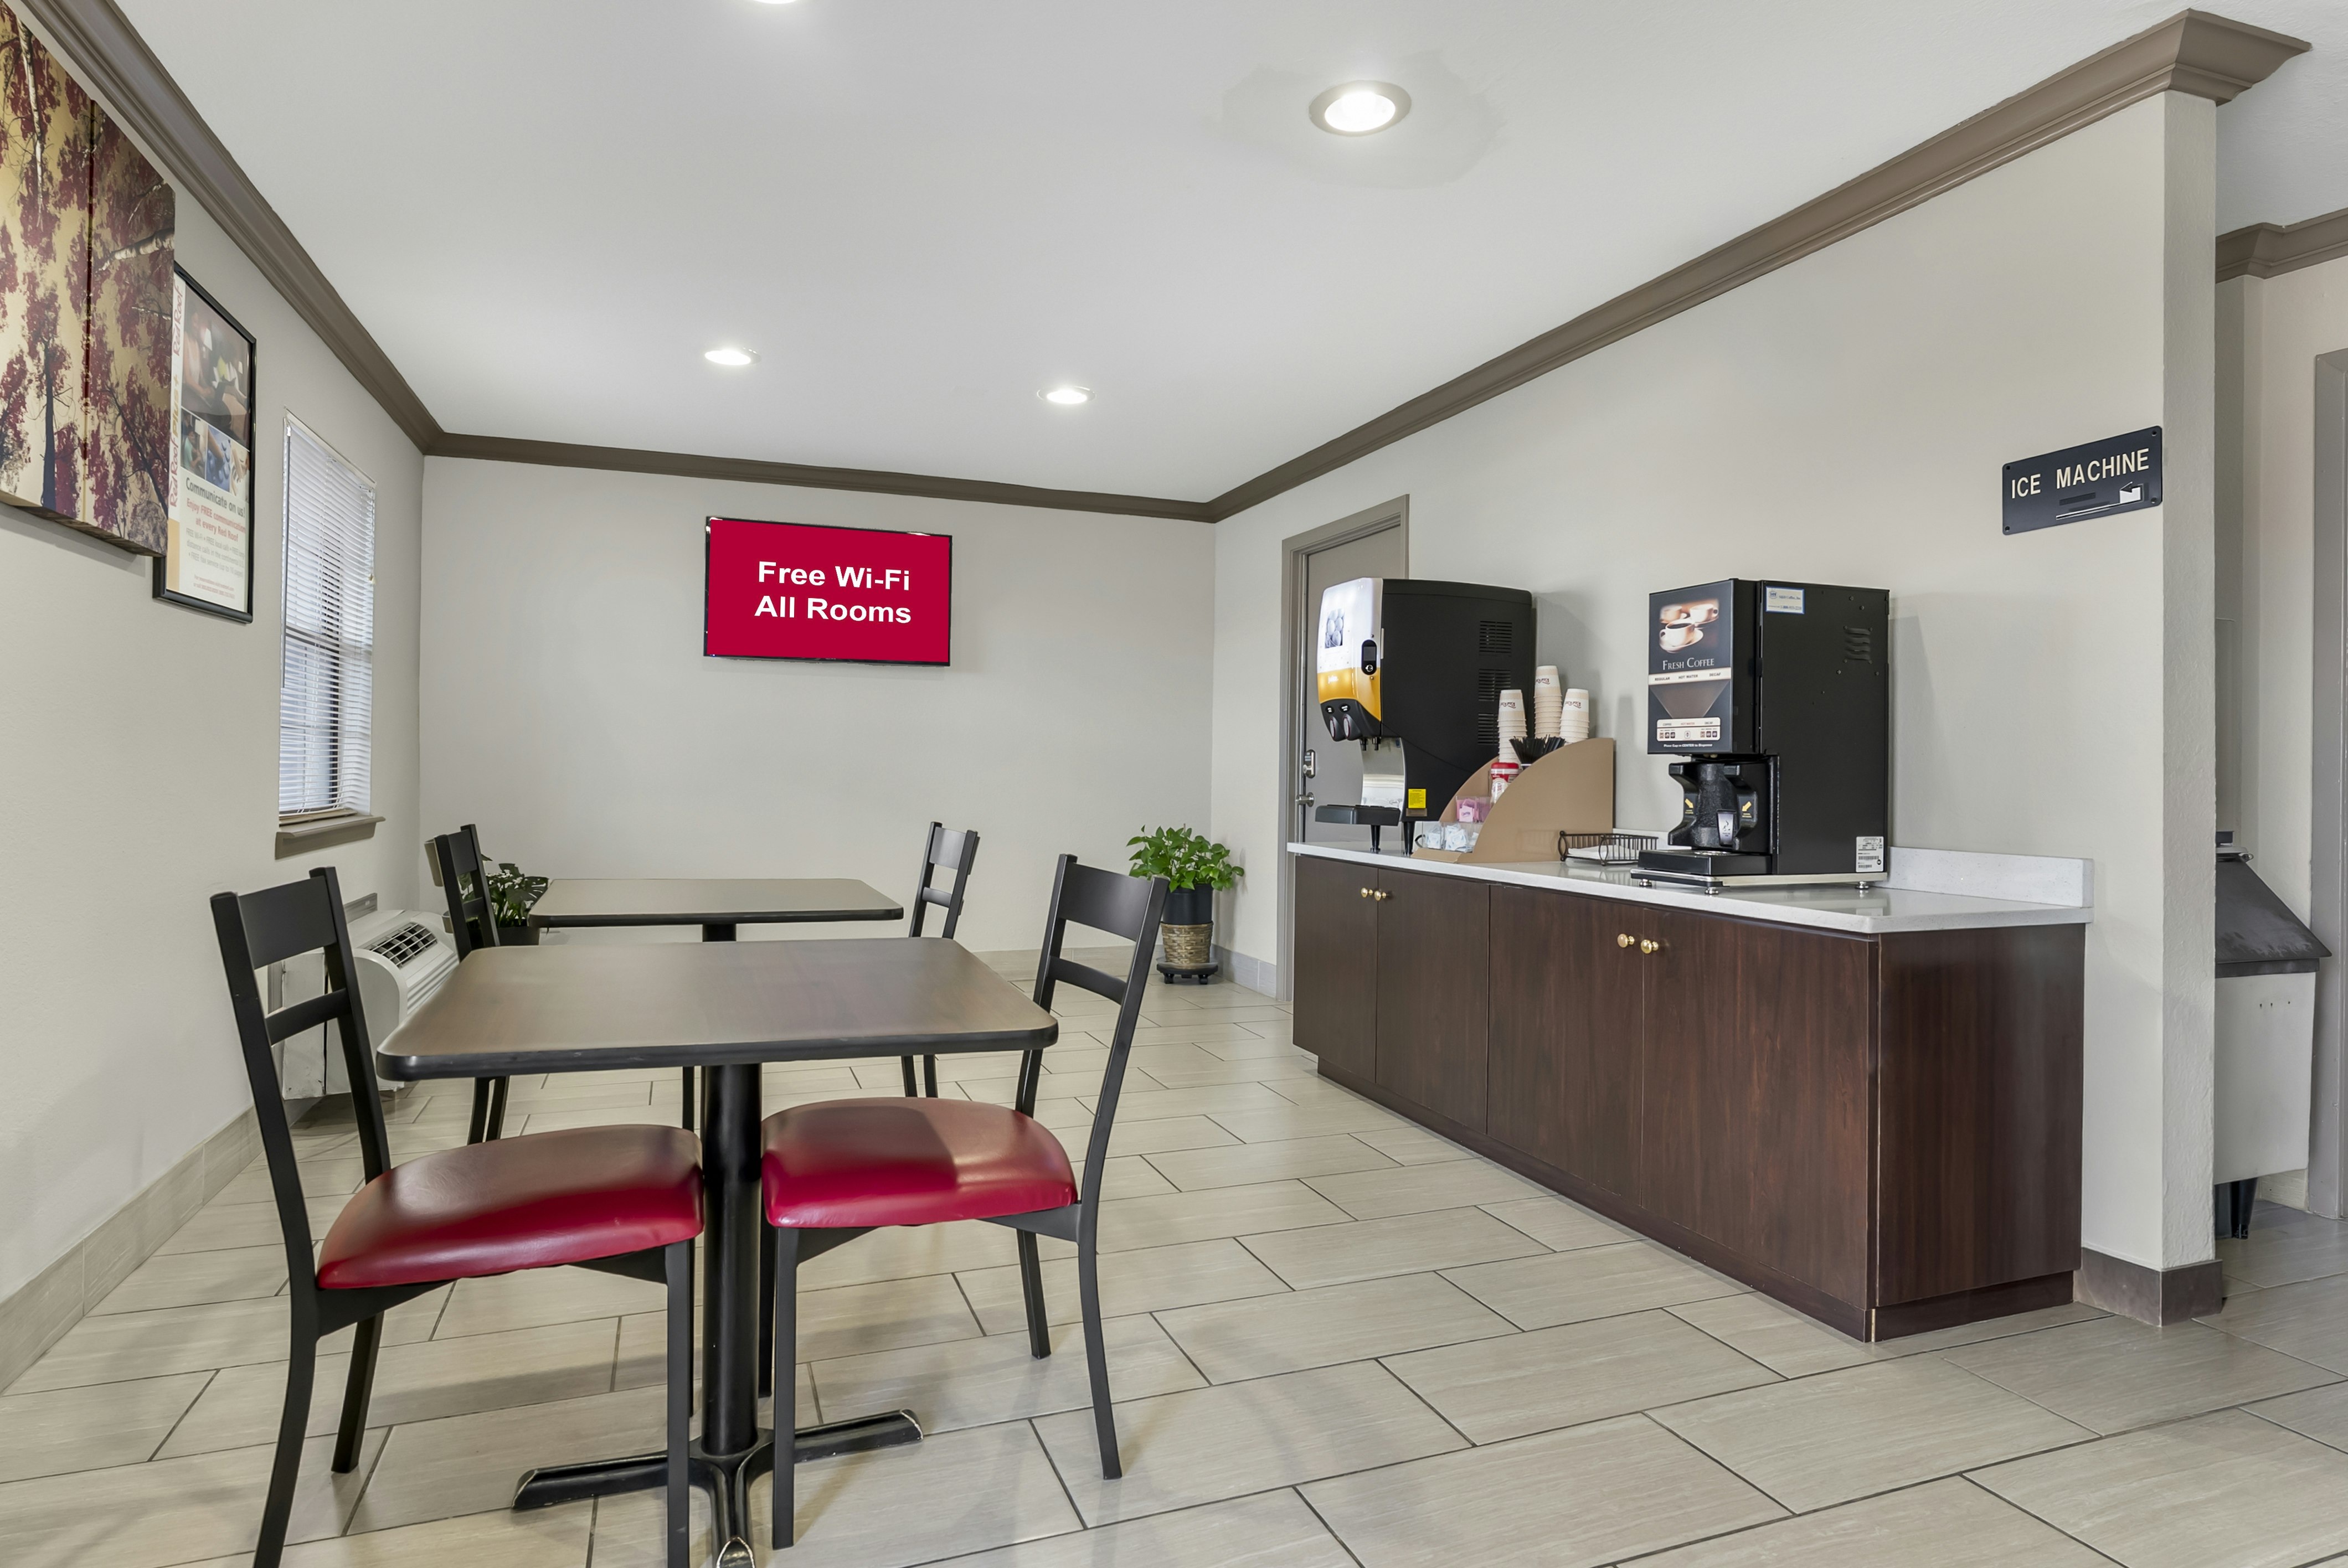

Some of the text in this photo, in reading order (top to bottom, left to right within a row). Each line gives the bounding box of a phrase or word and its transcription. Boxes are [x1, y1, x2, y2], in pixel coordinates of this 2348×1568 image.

[173, 280, 183, 356] Red Roof
[171, 434, 179, 476] Roof
[2011, 448, 2150, 499] ICE MACHINE
[168, 476, 178, 507] Red
[186, 477, 245, 518] Communicate on us!
[187, 498, 199, 514] Enjoy
[200, 504, 213, 518] FREE
[195, 518, 238, 542] at every Red Roof
[759, 561, 909, 591] Free Wi-Fi
[754, 595, 912, 624] All Rooms
[1662, 657, 1714, 670] FRESH COFFEE
